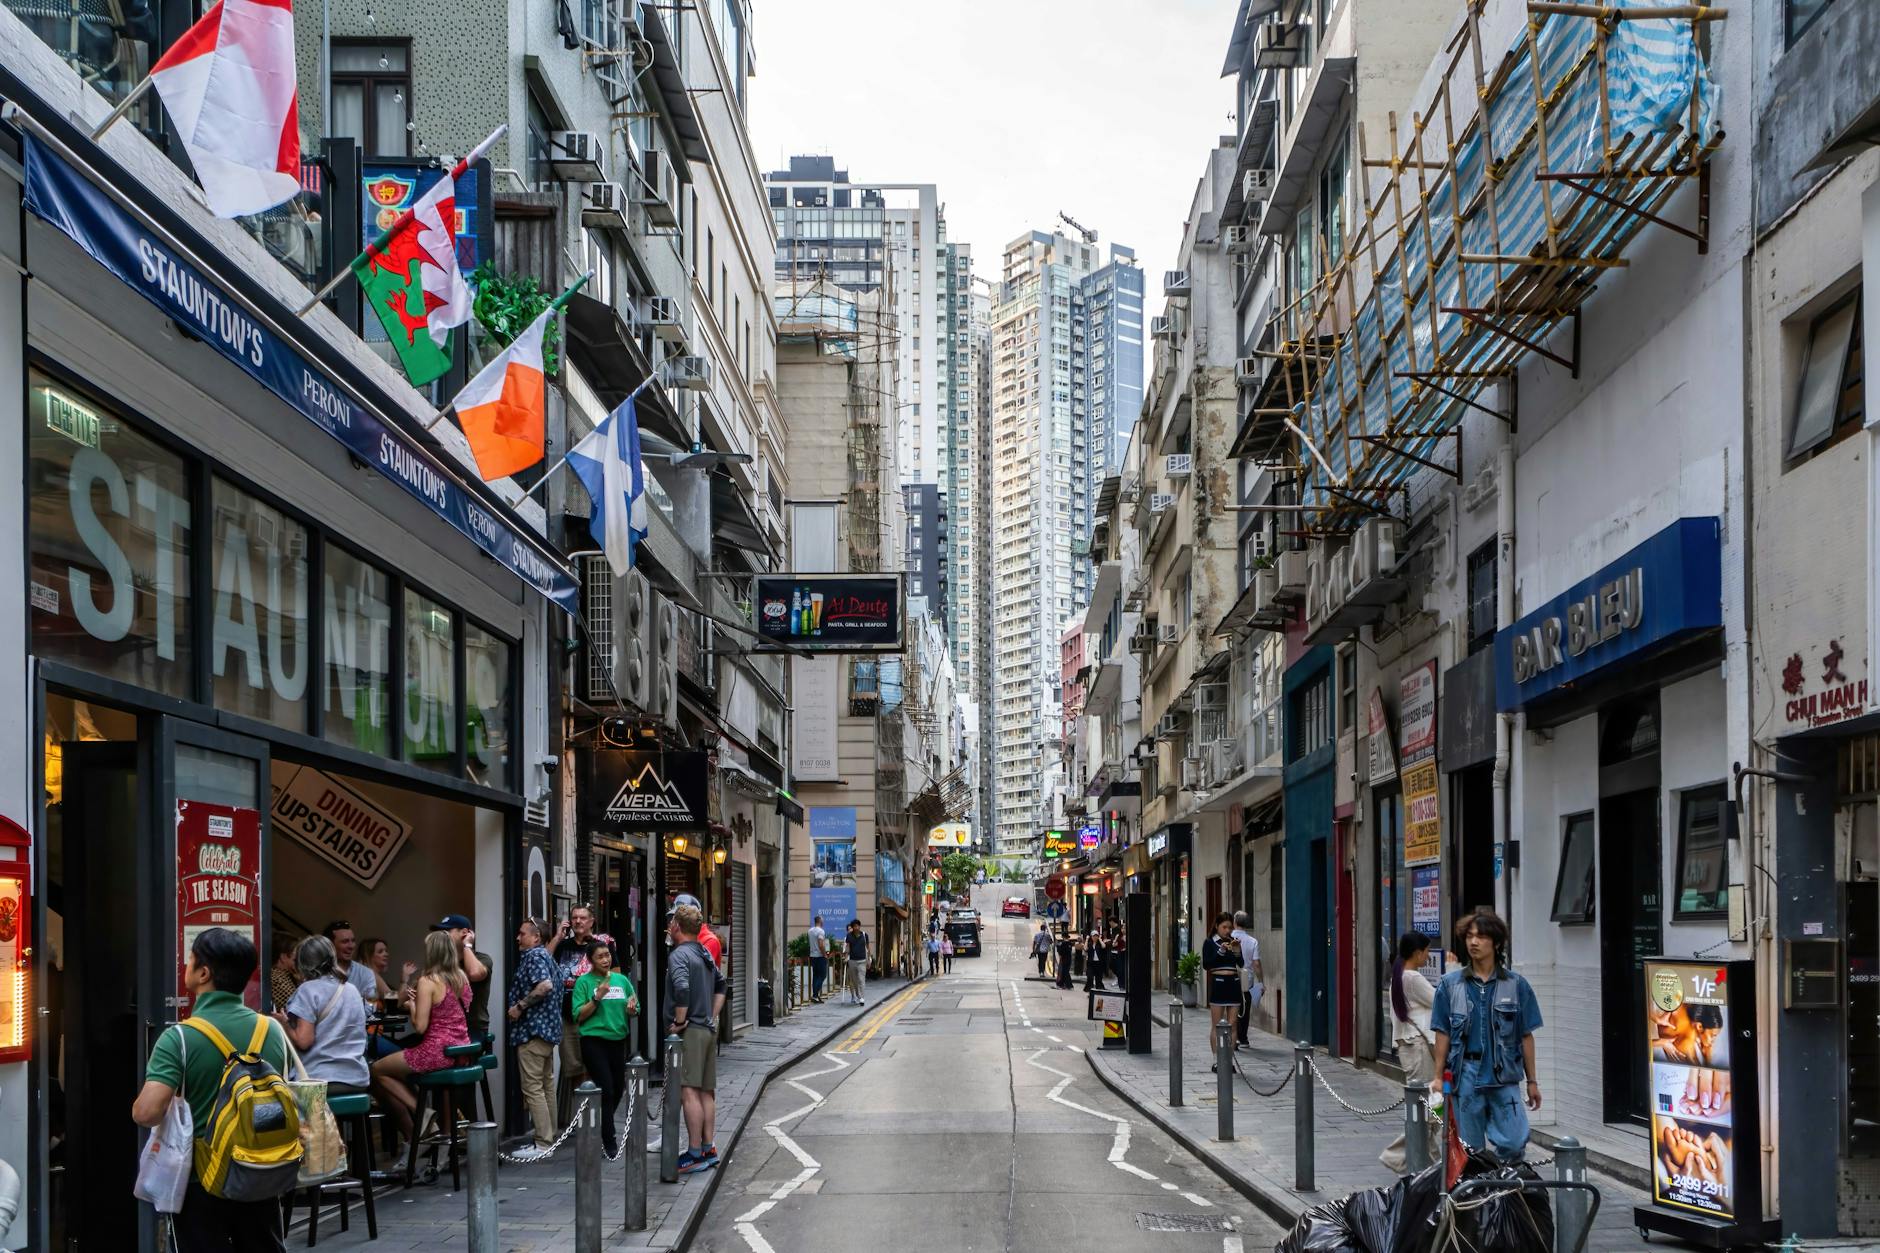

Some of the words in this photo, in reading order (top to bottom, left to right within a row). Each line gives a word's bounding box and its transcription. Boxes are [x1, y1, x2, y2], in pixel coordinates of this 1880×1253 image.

[140, 238, 263, 368] STAUNTON'S
[304, 368, 350, 428] PERONI
[380, 433, 446, 509] STAUNTON'S
[468, 504, 496, 543] PERONI
[1513, 617, 1564, 684] BAR
[1568, 567, 1643, 657] BLEU
[1786, 694, 1817, 722] CHUI
[1821, 683, 1854, 714] MAN
[1813, 712, 1841, 727] Staunton
[1843, 704, 1863, 720] Street
[317, 789, 390, 848] DINING
[604, 812, 650, 822] Nepalese
[654, 812, 694, 822] Cuisine
[616, 794, 680, 808] NEPAL
[277, 794, 377, 871] UPSTAIRS
[192, 880, 210, 904] THE
[212, 880, 247, 905] SEASON
[1692, 975, 1716, 998] 1/F
[1673, 1174, 1701, 1192] 2499
[1702, 1180, 1729, 1198] 2911
